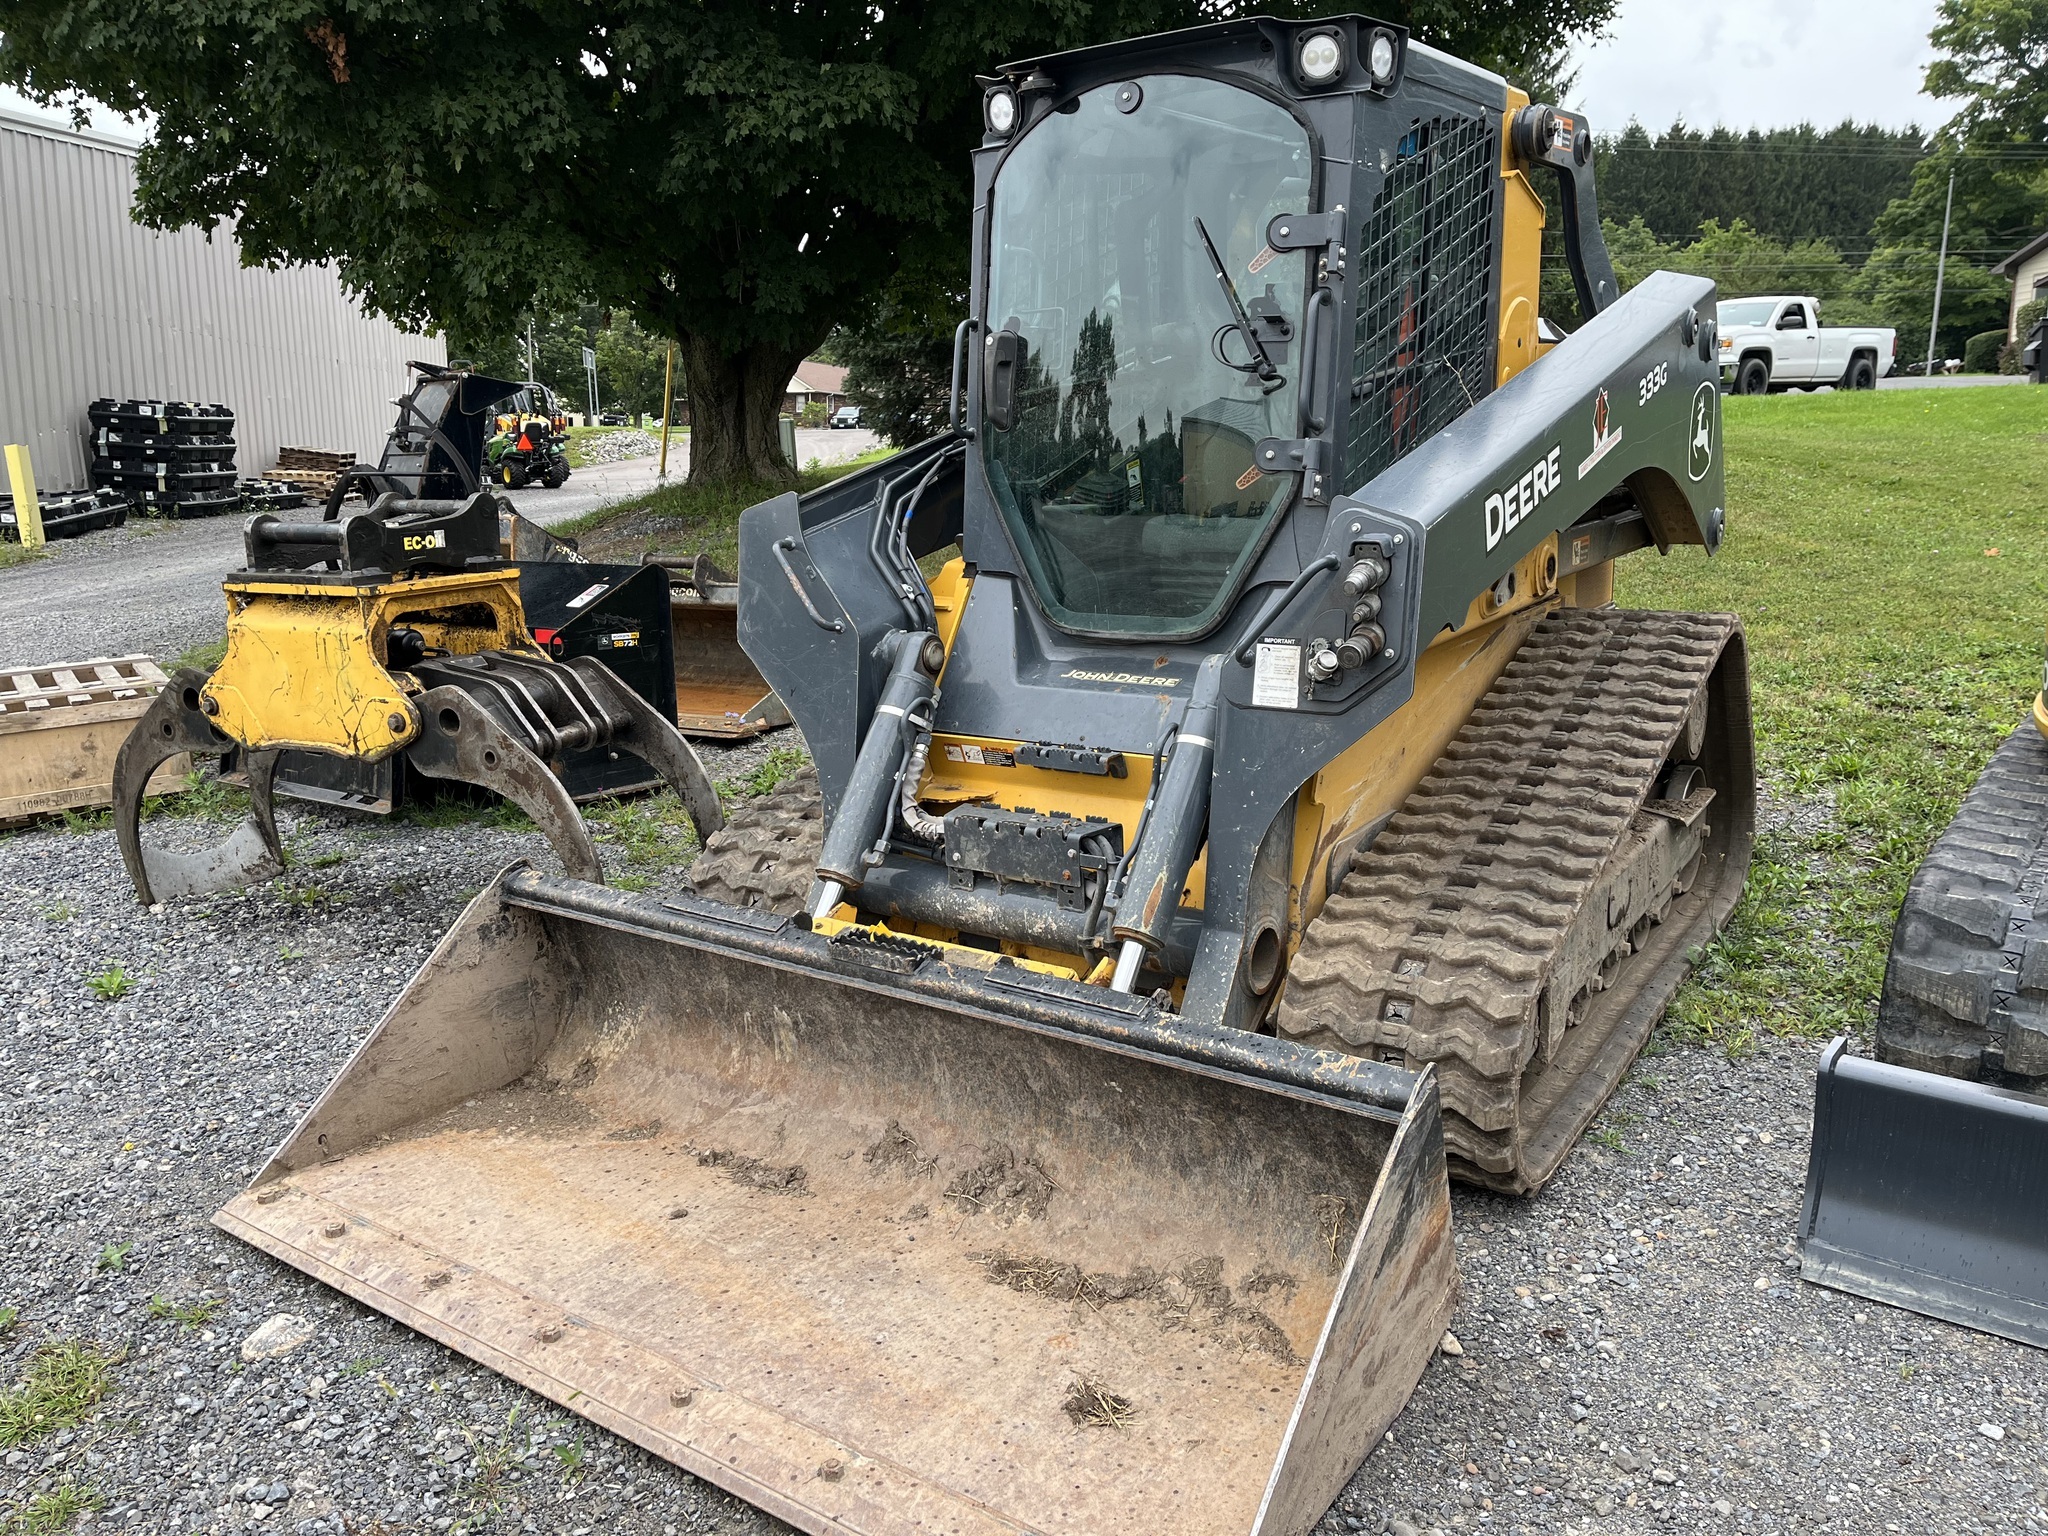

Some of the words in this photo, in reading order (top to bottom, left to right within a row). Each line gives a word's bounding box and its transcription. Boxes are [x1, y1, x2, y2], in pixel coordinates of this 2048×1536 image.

[1638, 361, 1668, 407] 333G
[1484, 444, 1561, 552] DEERE
[613, 639, 638, 648] SB72H
[1263, 637, 1296, 645] IMPORTANT
[1060, 669, 1113, 682] JOHN
[1114, 672, 1182, 688] DEERE
